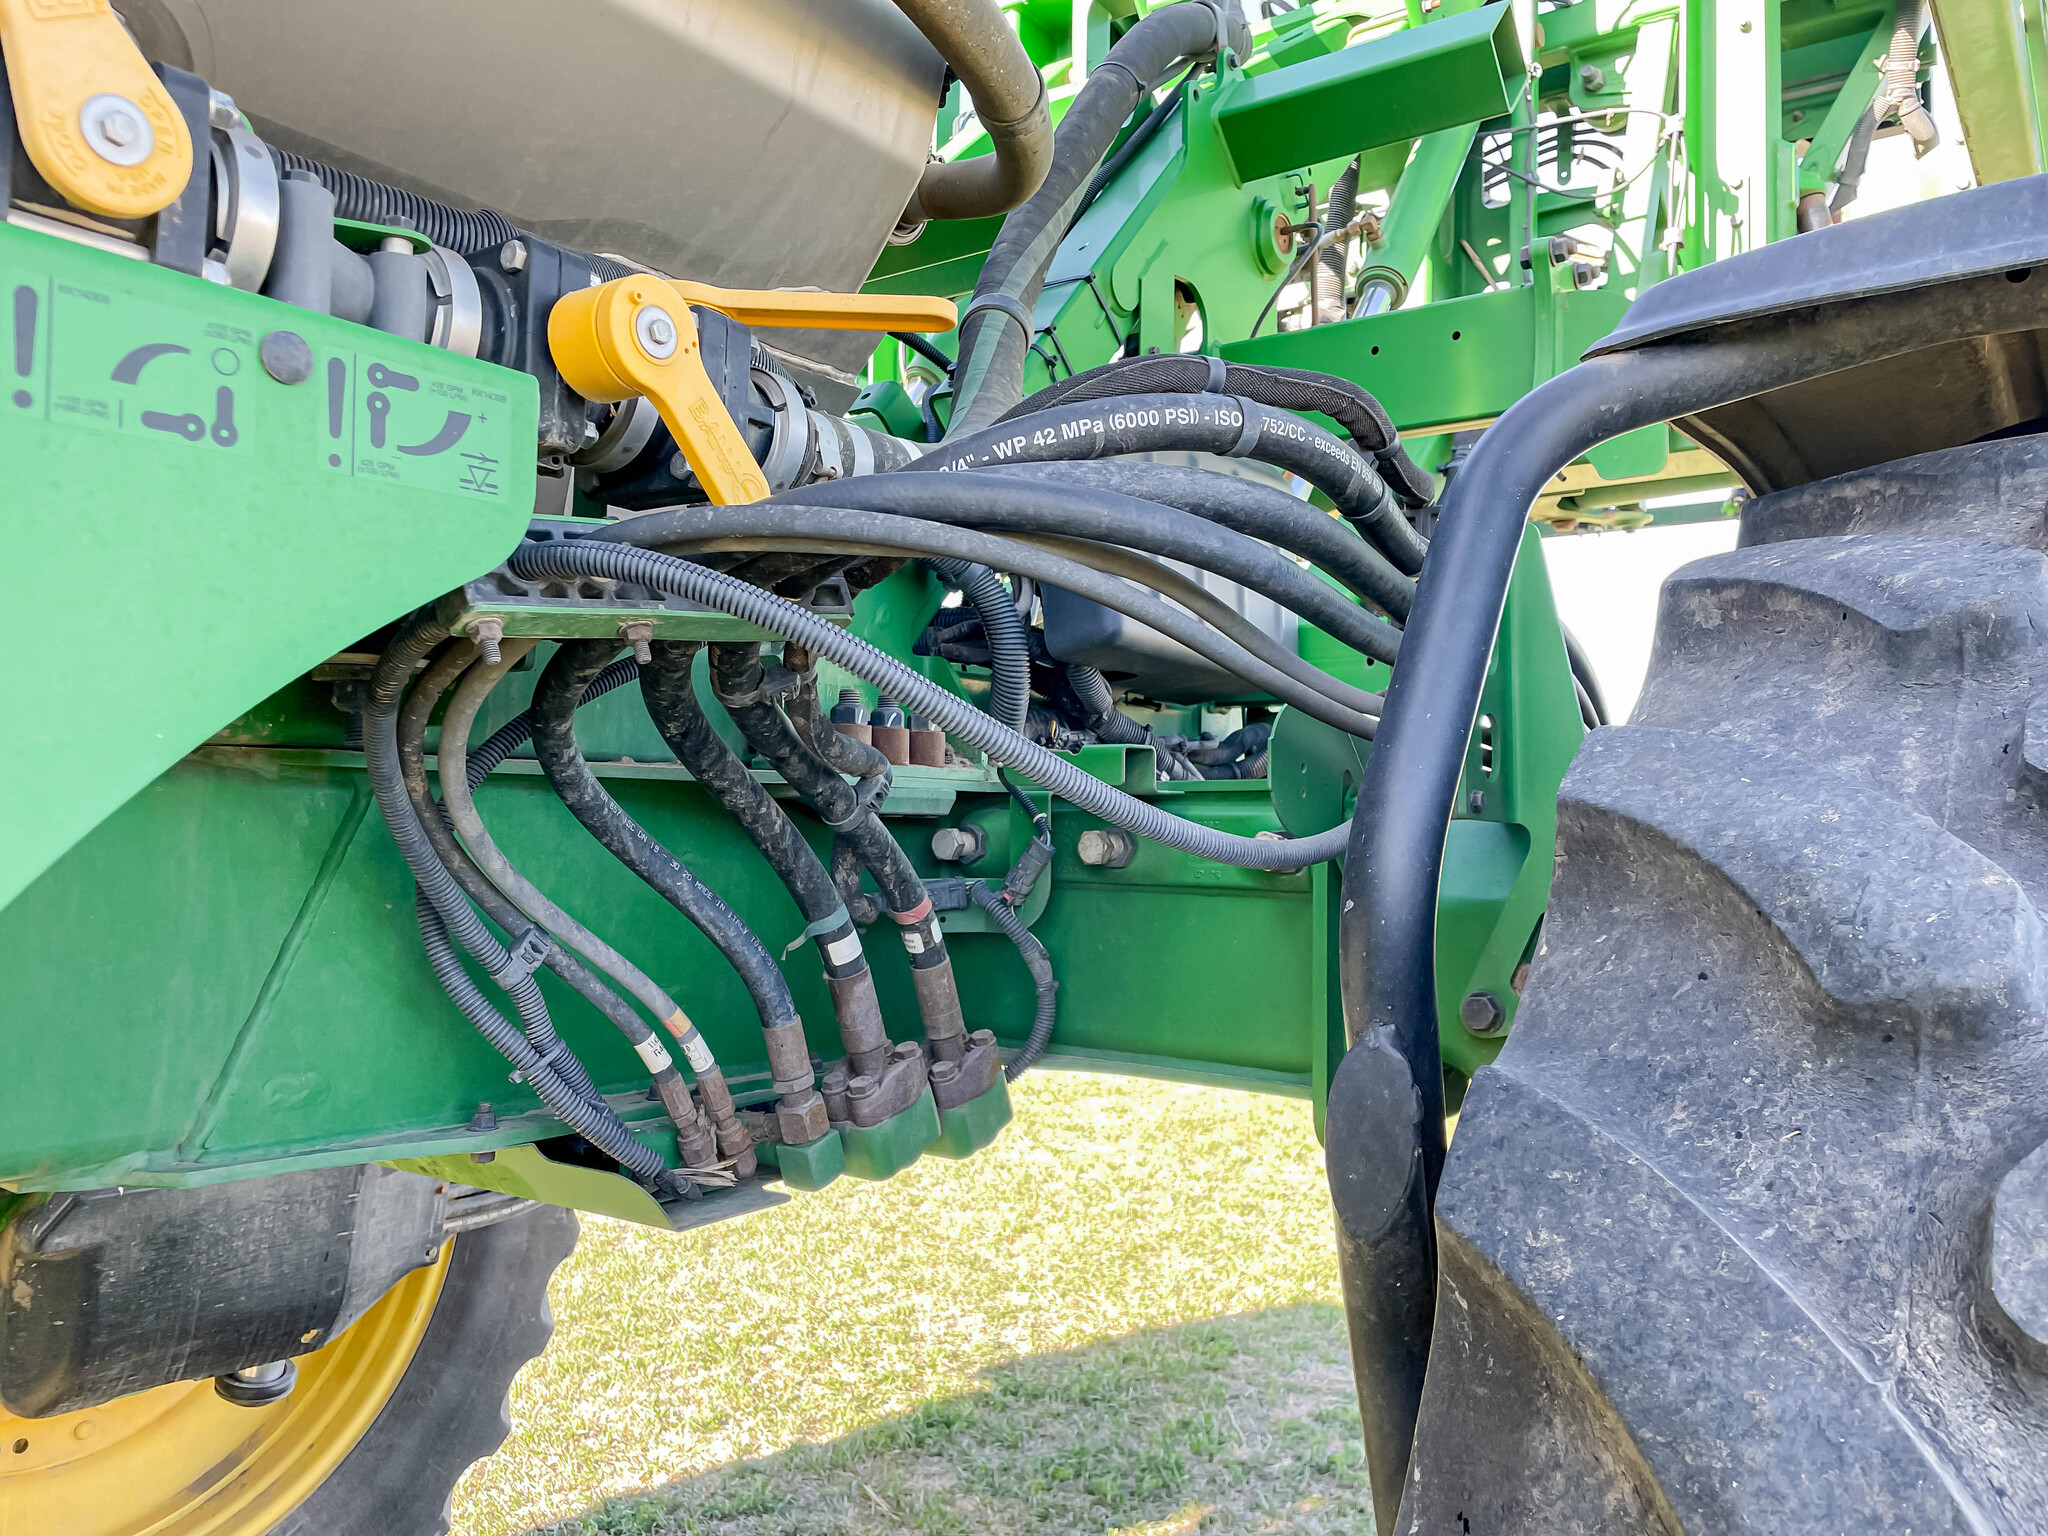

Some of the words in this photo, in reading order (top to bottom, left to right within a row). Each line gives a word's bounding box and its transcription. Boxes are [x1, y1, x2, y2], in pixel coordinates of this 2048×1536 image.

[992, 436, 1027, 460] WP
[1033, 427, 1058, 447] 42
[1060, 418, 1105, 441] MPa
[1109, 410, 1160, 430] (6000
[1164, 408, 1200, 425] PSI)
[1214, 409, 1243, 427] ISO
[1260, 416, 1306, 442] 752/CC
[1314, 436, 1350, 466] exceeds
[1350, 455, 1362, 475] EN
[637, 830, 648, 843] DN
[650, 842, 660, 853] 19
[682, 870, 693, 881] 20
[694, 880, 714, 900] MADE
[716, 900, 726, 911] IN
[727, 911, 749, 935] ITALY
